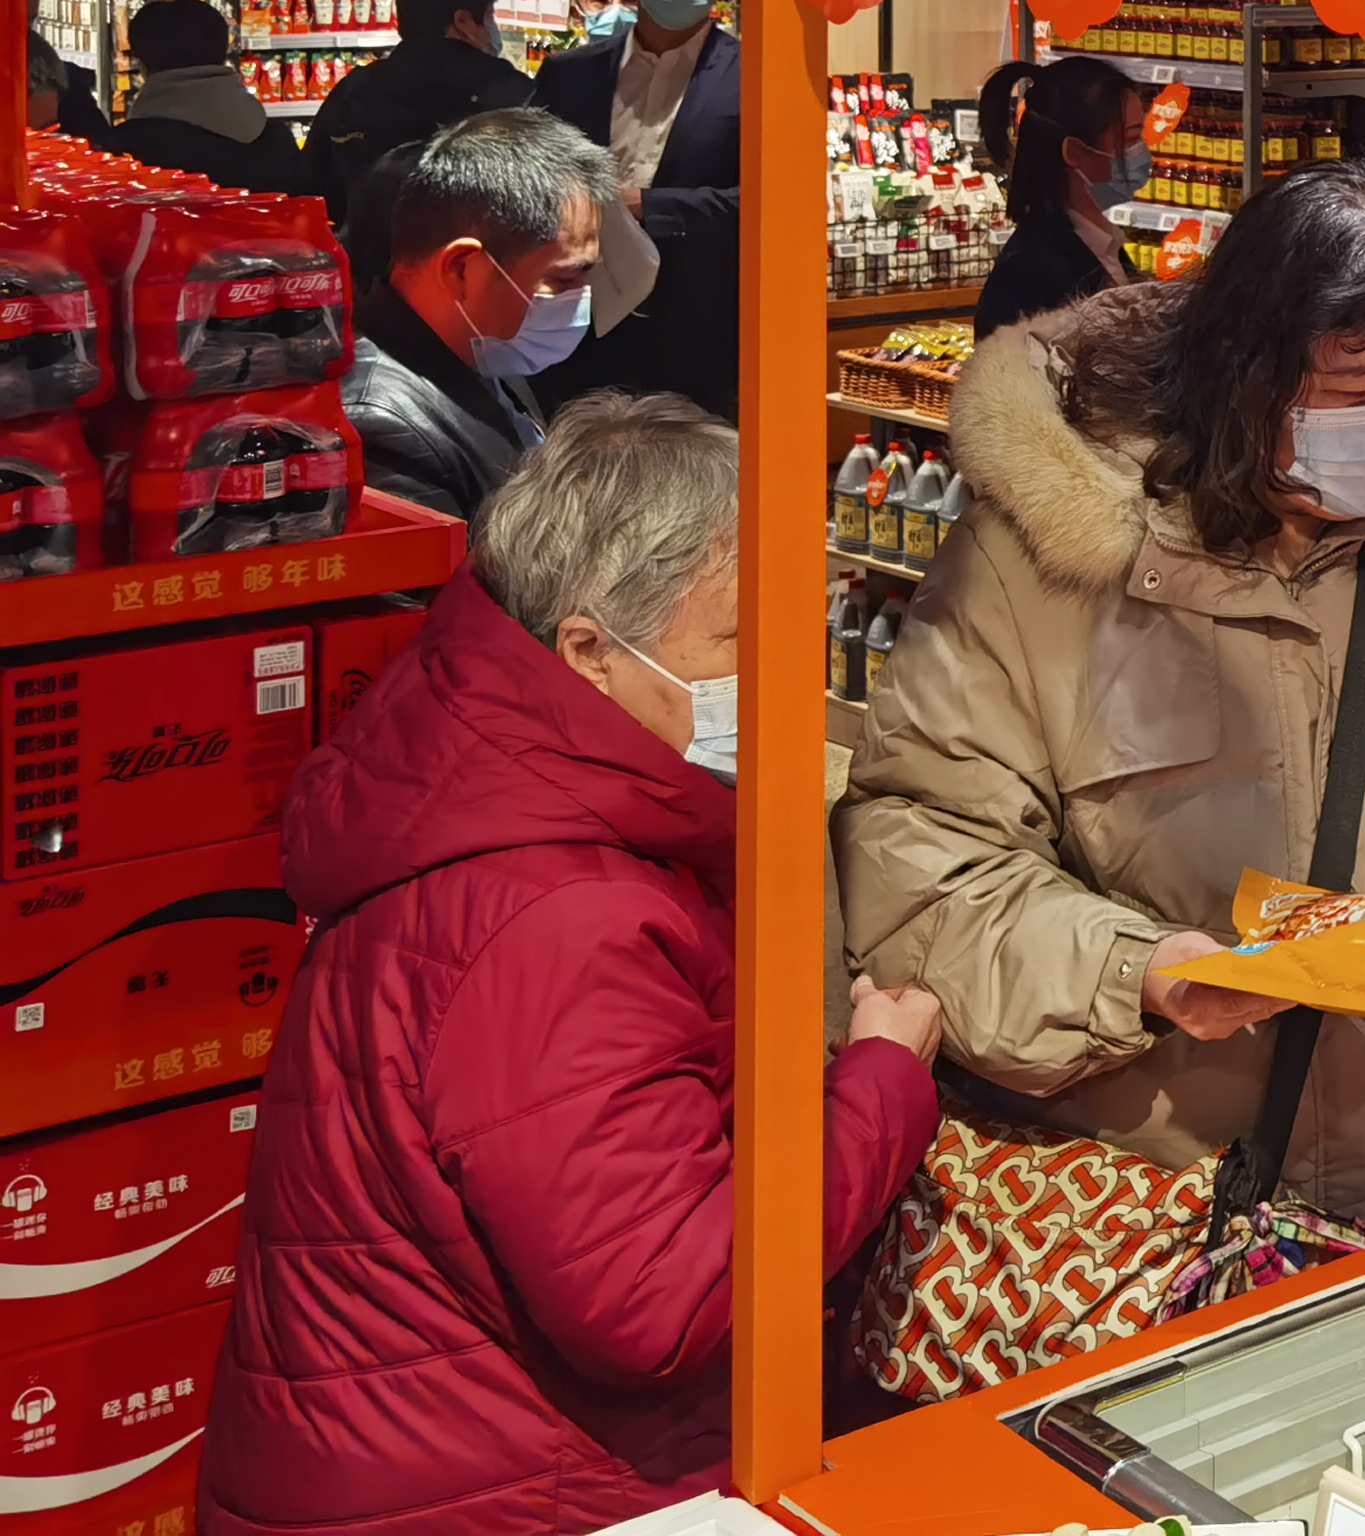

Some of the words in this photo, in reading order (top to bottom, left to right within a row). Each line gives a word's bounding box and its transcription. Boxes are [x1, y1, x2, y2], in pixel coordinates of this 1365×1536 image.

[113, 571, 223, 611] 这感觉
[243, 554, 348, 589] 够年味
[98, 728, 231, 784] 可口可乐
[114, 1039, 222, 1091] 这感觉
[242, 1028, 273, 1060] 够
[94, 1174, 189, 1211] 经典美味
[102, 1378, 195, 1419] 经典美味
